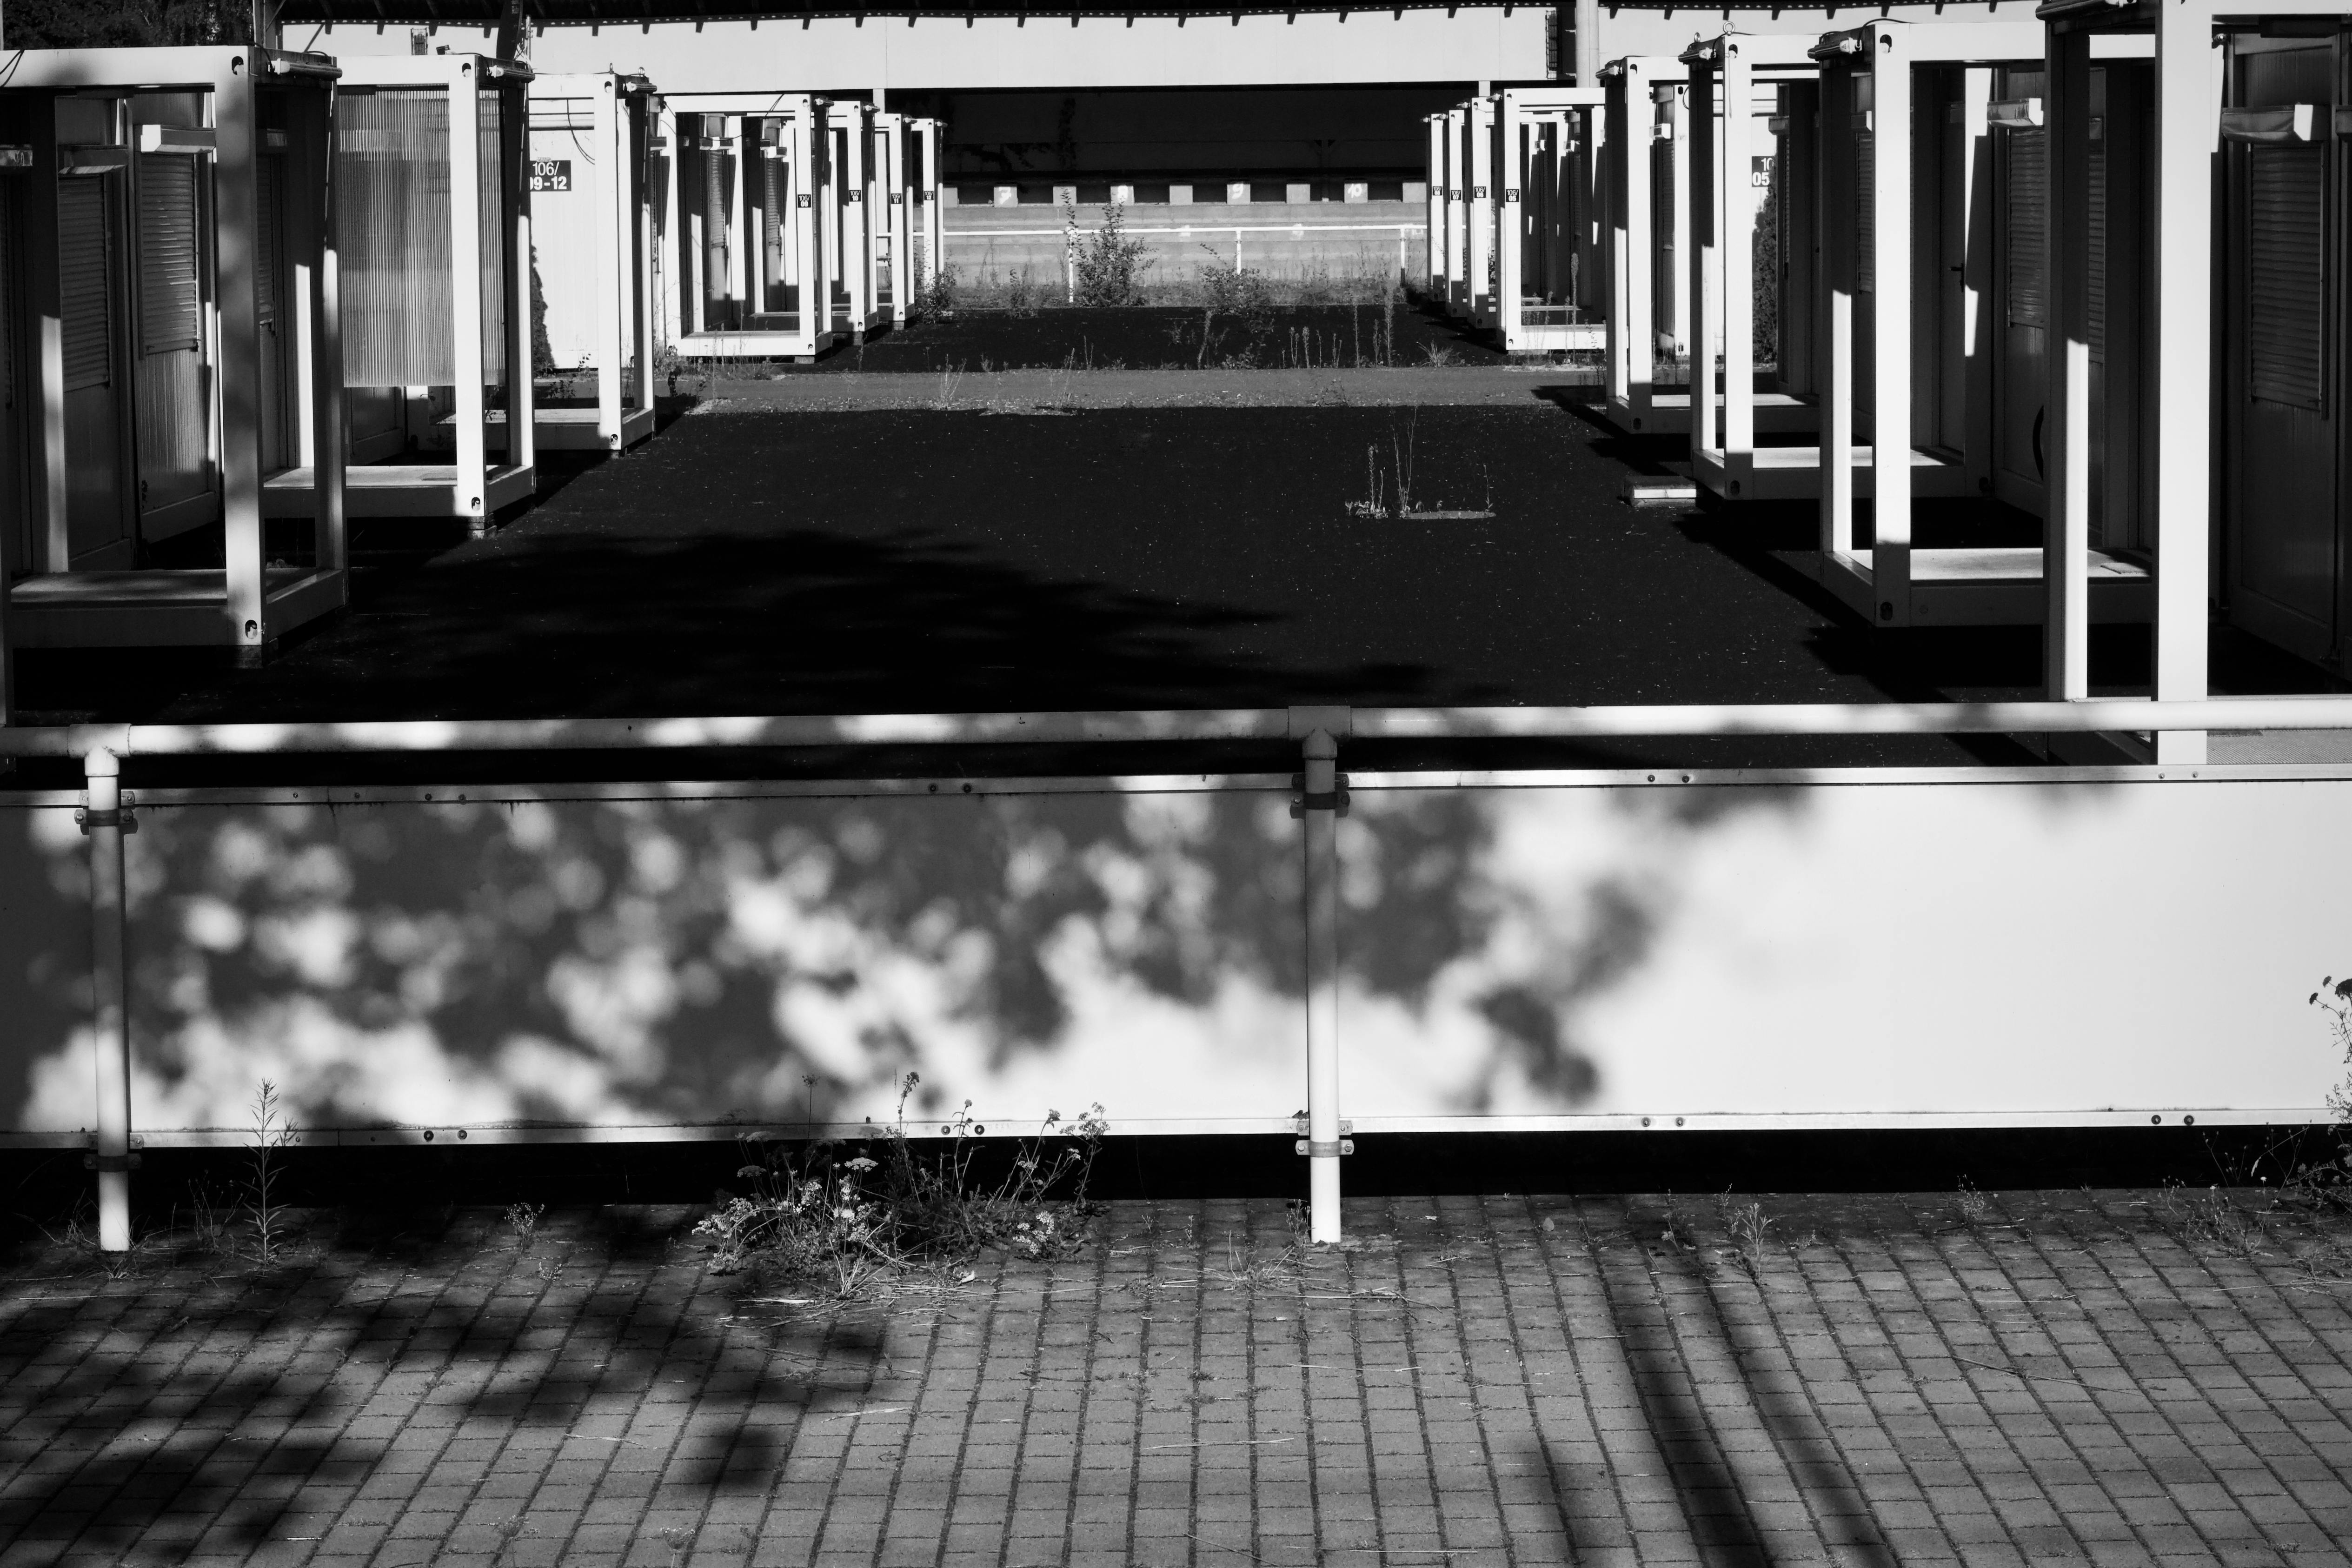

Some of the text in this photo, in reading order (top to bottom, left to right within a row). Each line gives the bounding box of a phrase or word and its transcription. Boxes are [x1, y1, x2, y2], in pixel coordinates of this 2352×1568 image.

[532, 161, 559, 176] 106/
[1231, 182, 1244, 199] 9
[1347, 183, 1362, 198] 10
